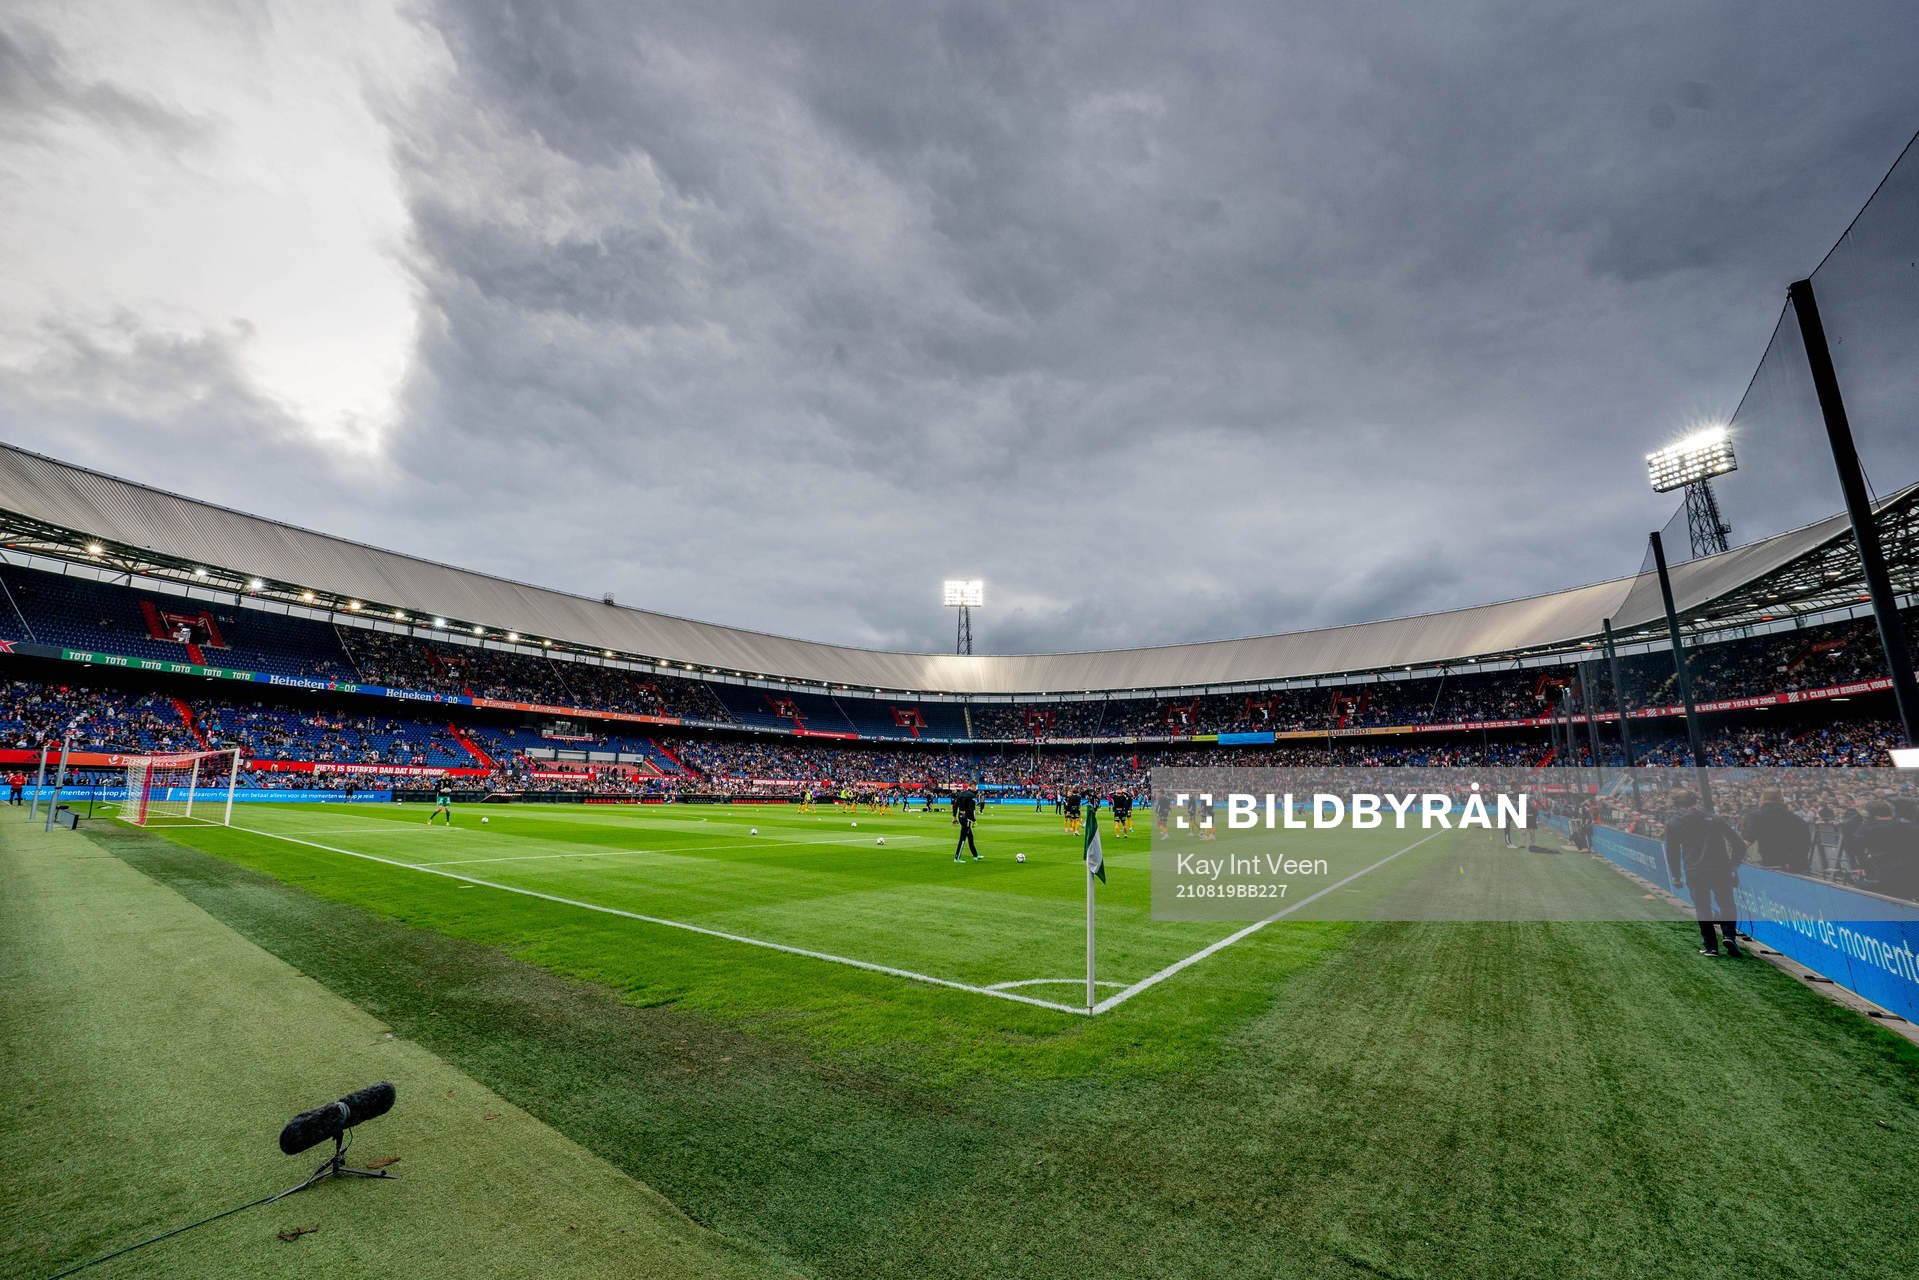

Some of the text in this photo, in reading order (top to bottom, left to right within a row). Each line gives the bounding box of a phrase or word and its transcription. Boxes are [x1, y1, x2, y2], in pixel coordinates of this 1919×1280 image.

[69, 651, 92, 662] TOTO
[105, 656, 127, 666] TOTO
[141, 660, 162, 670] TOTO
[171, 664, 190, 673] TOTO
[203, 668, 222, 677] TOTO
[232, 671, 250, 680] TOTO
[269, 675, 325, 690] Heineken
[385, 689, 432, 702] Heineken
[1758, 889, 1790, 928] alleen
[1789, 907, 1817, 941] voor
[1817, 908, 1838, 950] de
[1838, 926, 1919, 984] moment
